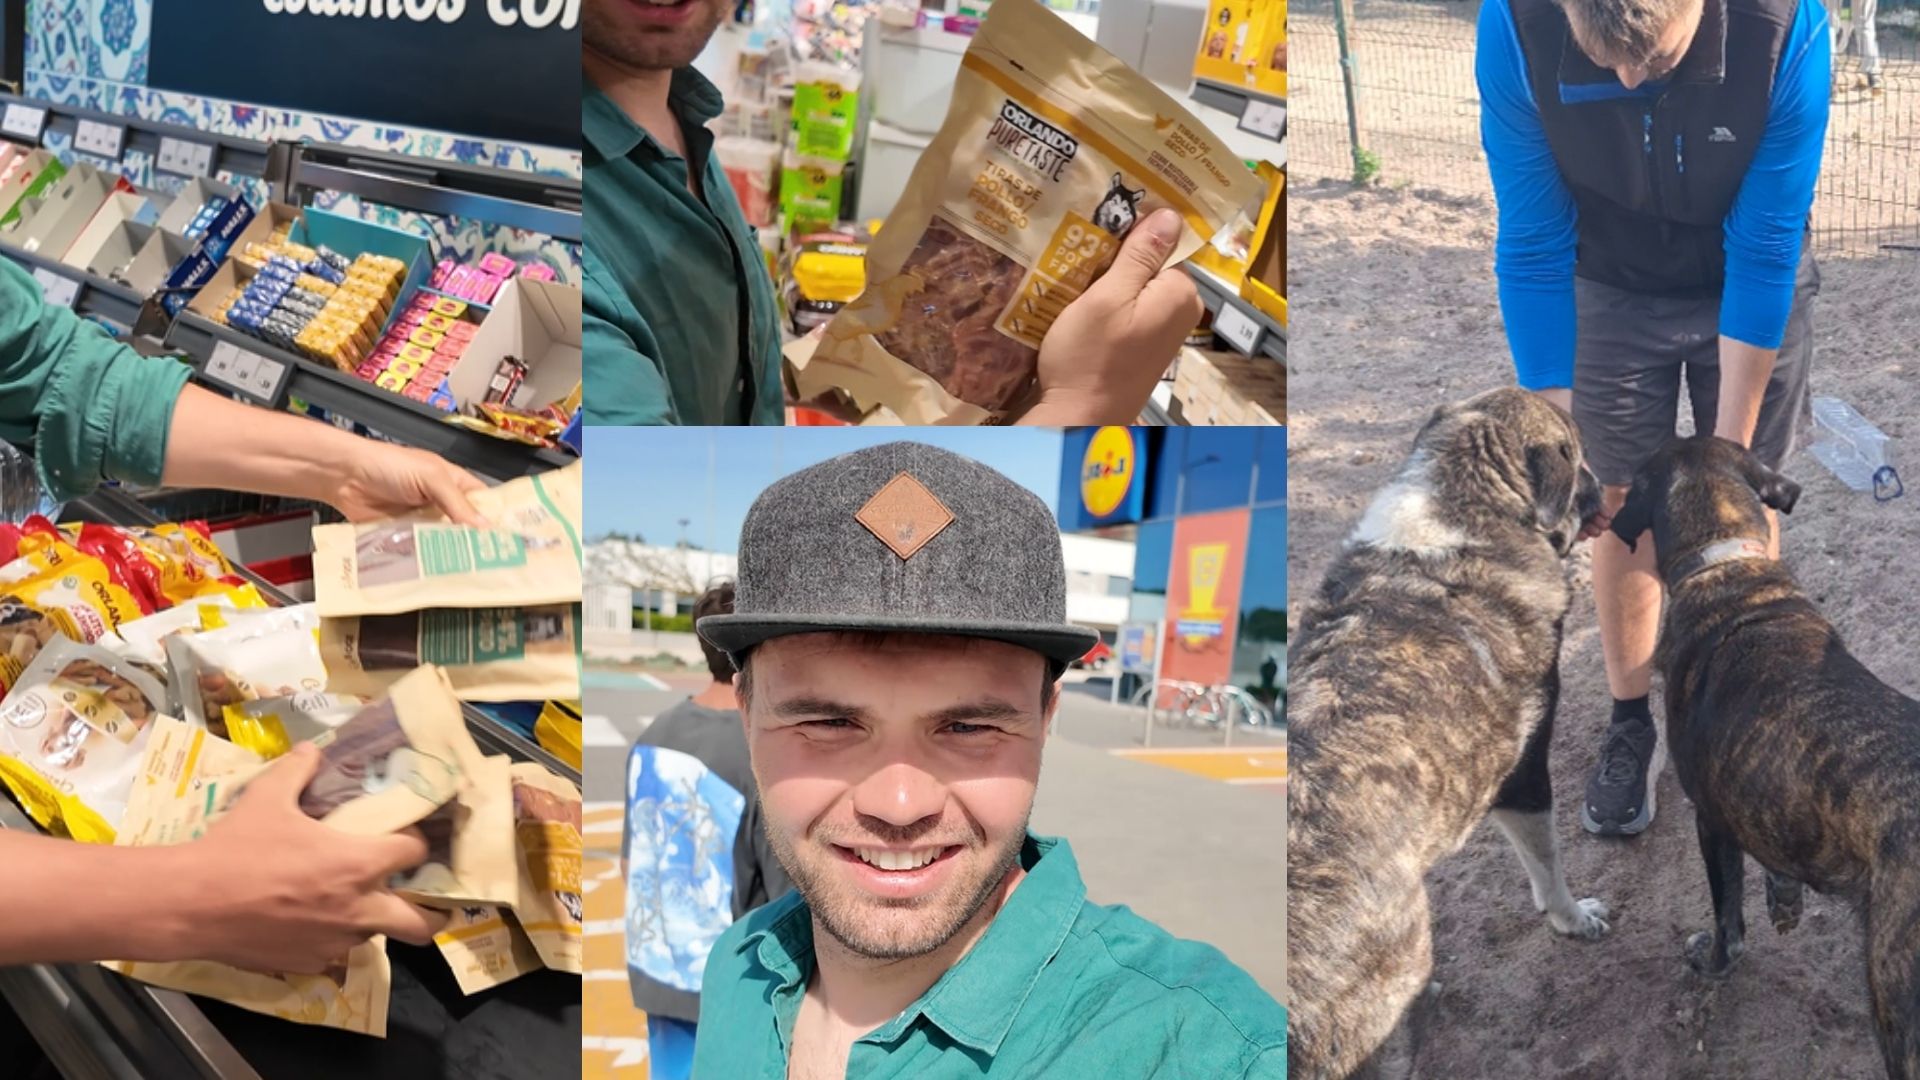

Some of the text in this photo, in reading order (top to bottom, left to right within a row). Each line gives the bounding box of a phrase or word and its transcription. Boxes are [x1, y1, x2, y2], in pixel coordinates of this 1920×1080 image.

[1003, 104, 1076, 155] ORLANDO
[1177, 123, 1212, 155] TIRAS DE
[1164, 139, 1186, 159] SECO
[1170, 131, 1197, 155] POLLO
[1201, 157, 1231, 188] FRANGO
[976, 174, 1025, 209] POLLO
[985, 160, 1024, 190] TIRAS
[1023, 184, 1043, 201] DE
[967, 187, 1029, 230] FRANGO
[974, 210, 1009, 235] SECO
